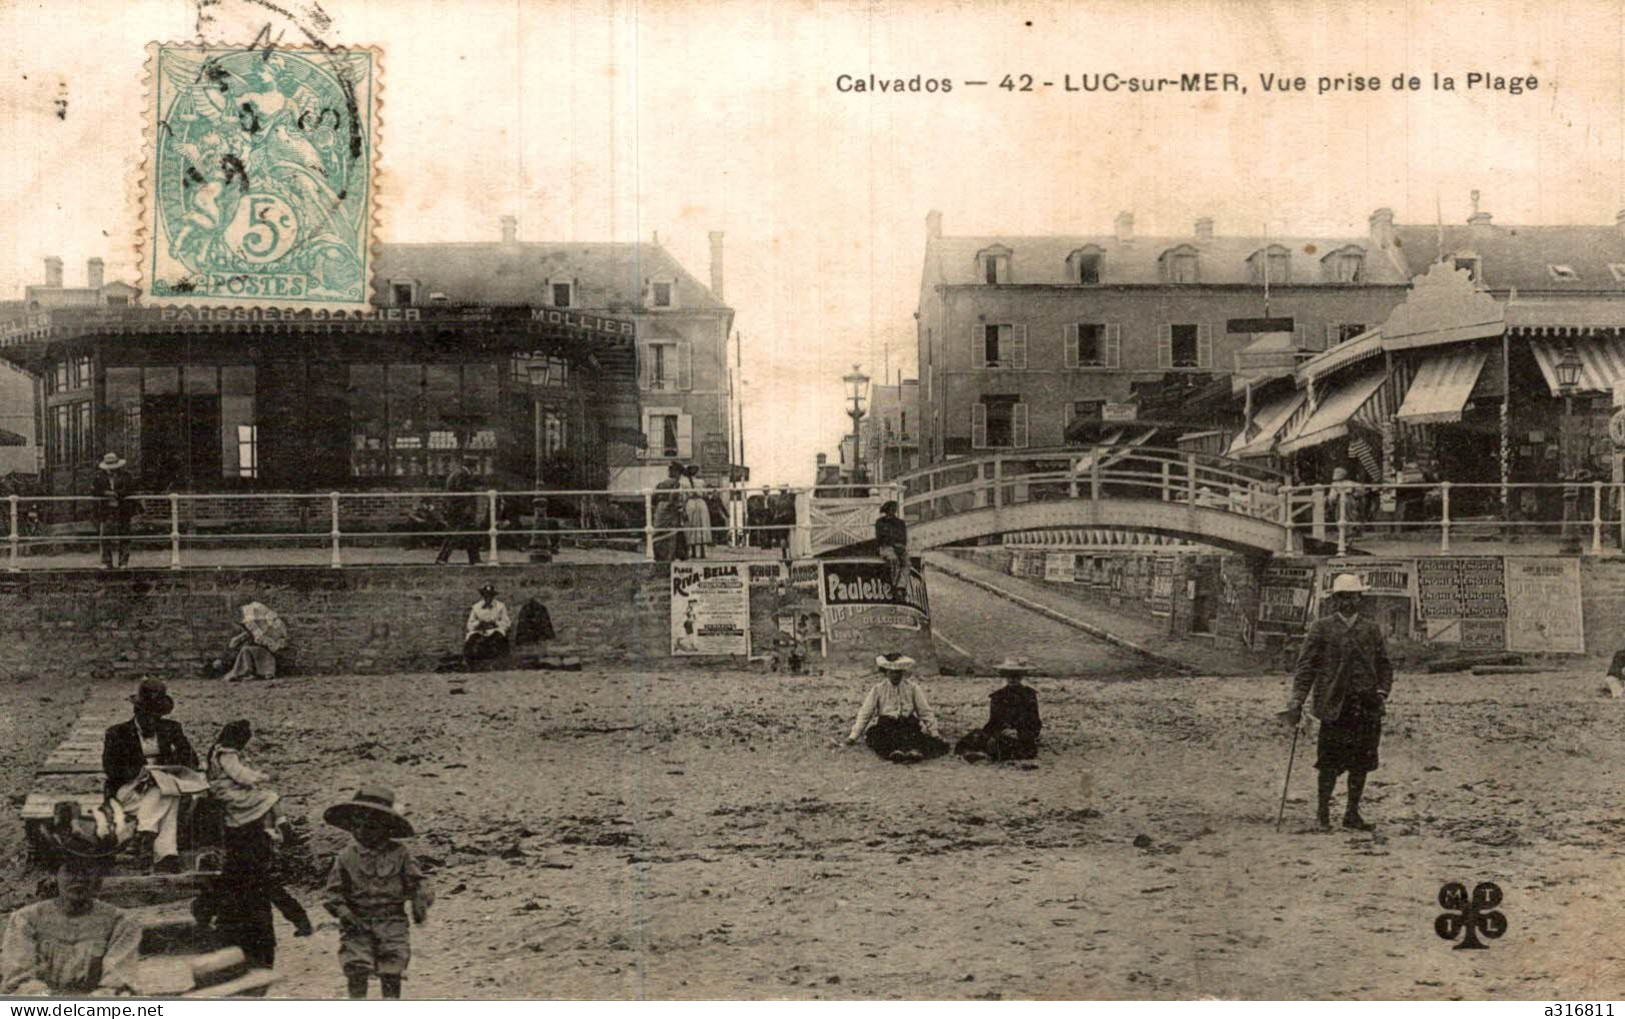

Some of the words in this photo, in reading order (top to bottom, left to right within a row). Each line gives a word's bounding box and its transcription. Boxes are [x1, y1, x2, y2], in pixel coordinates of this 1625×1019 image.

[211, 276, 304, 296] POSTES
[531, 308, 633, 335] MOLLIER
[828, 573, 893, 600] Paulette
